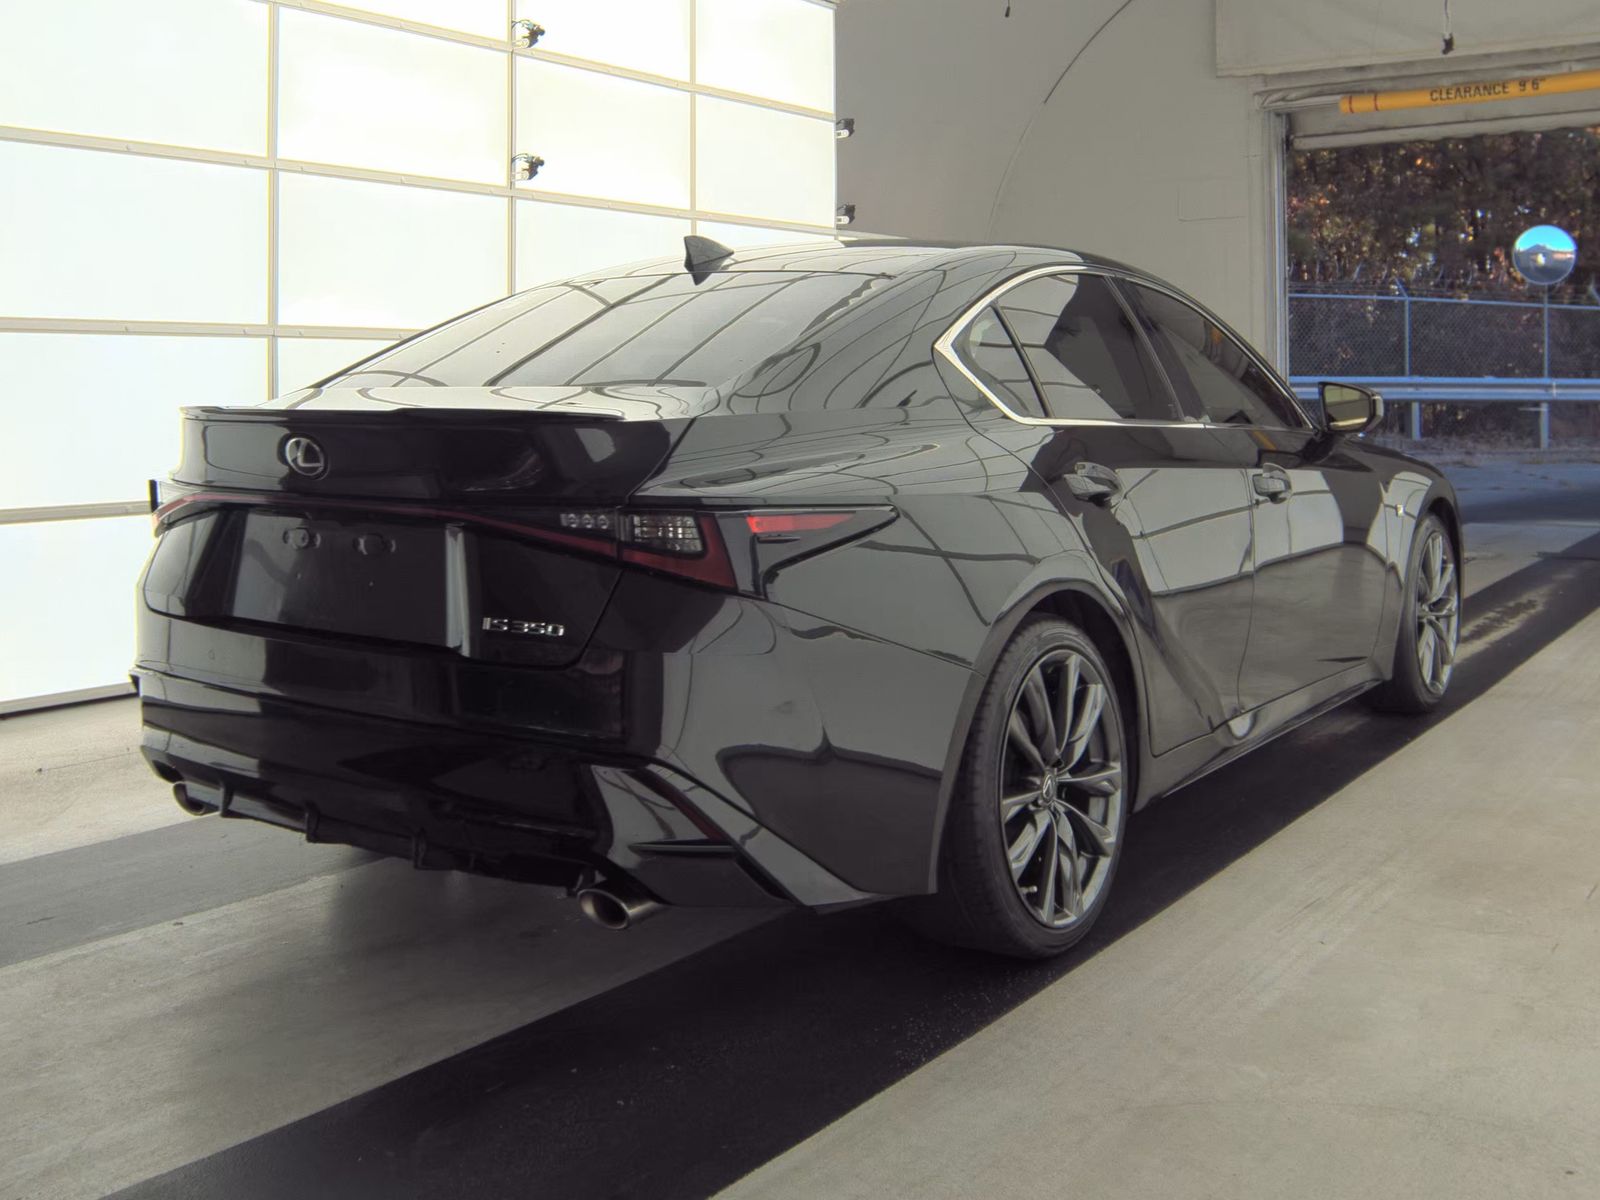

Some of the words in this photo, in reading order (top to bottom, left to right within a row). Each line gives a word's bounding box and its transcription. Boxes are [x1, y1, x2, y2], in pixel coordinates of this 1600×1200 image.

[1429, 82, 1510, 102] CLEARANCE
[482, 617, 508, 632] IS
[510, 619, 564, 636] 350
